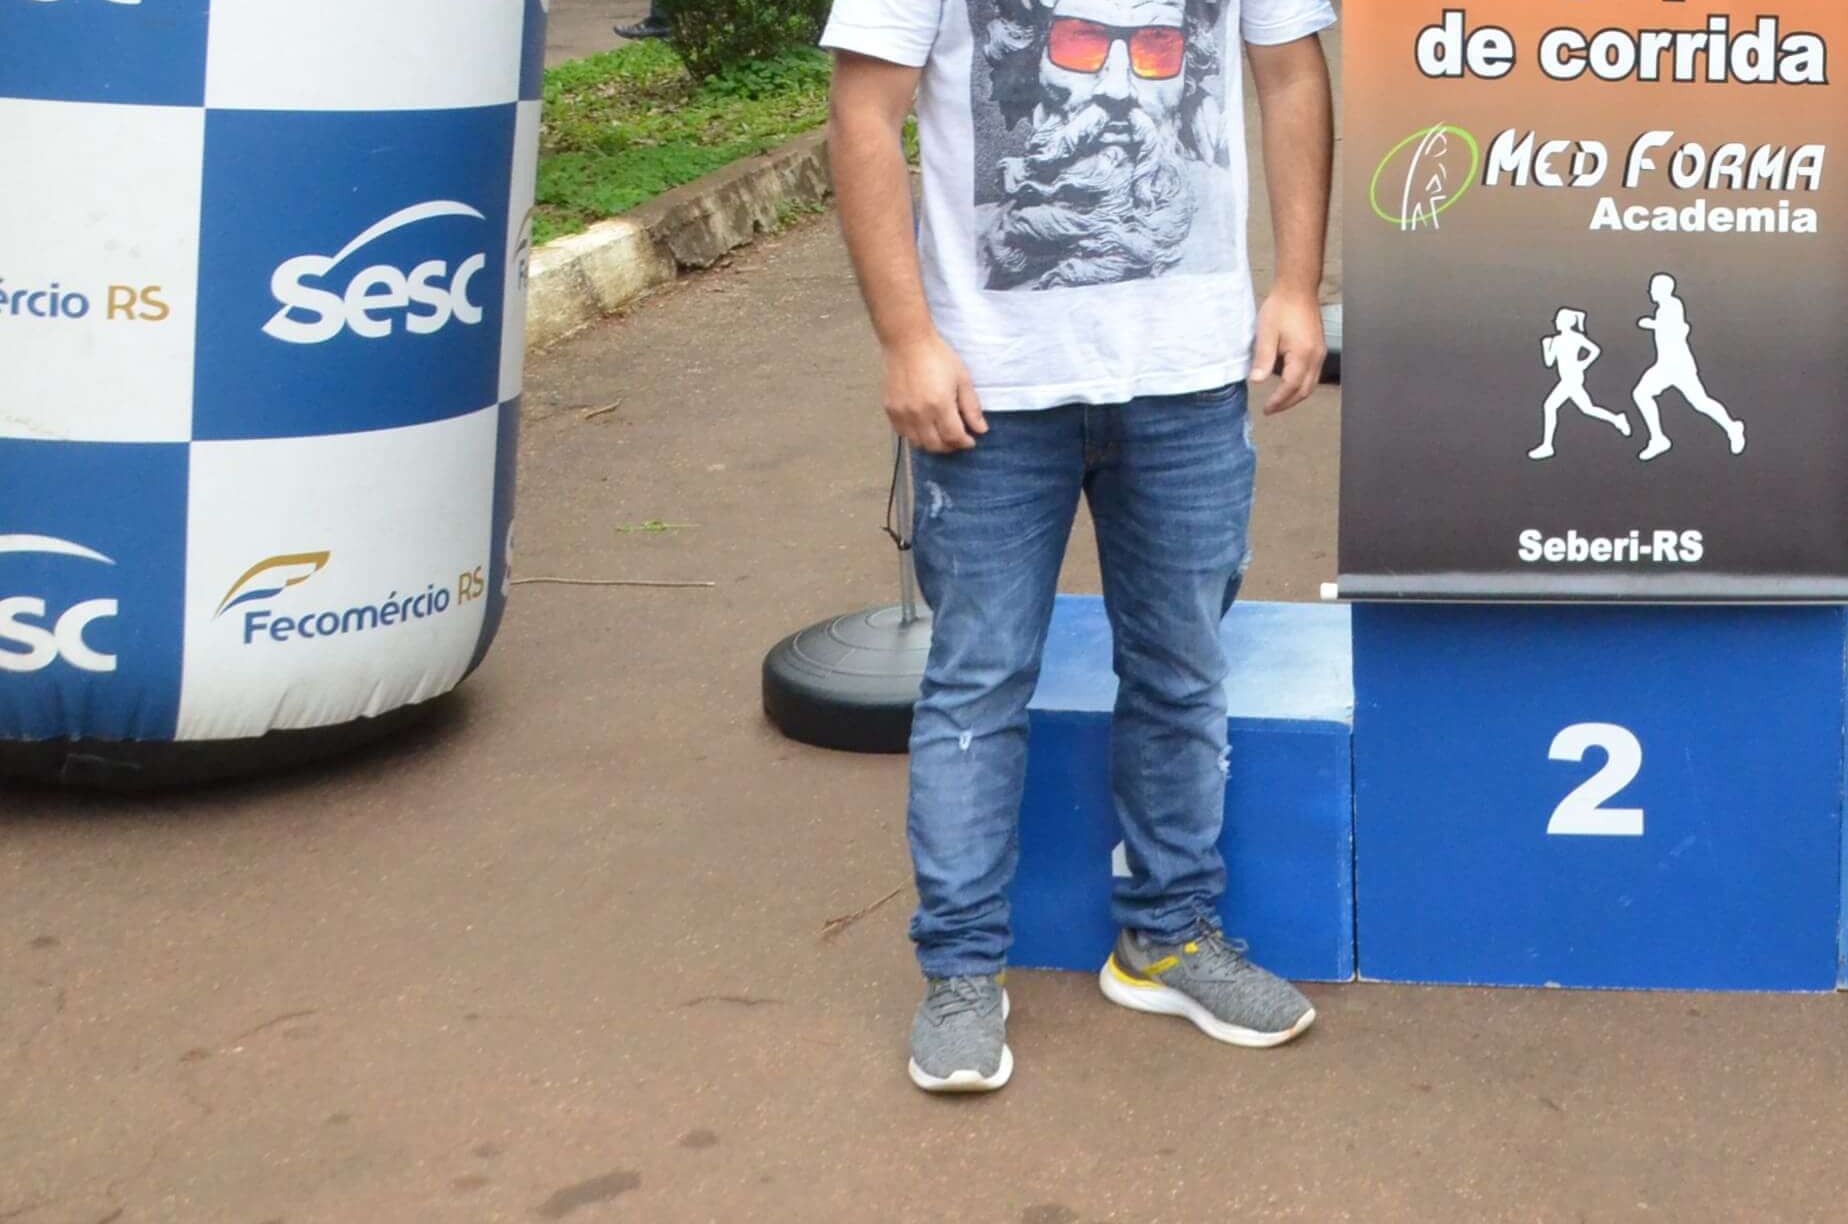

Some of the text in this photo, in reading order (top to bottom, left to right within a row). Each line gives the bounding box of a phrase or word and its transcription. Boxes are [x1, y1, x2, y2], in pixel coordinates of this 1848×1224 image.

[1415, 9, 1829, 85] de corrida
[1622, 130, 1826, 191] FORMA
[1589, 196, 1818, 233] Academia
[106, 284, 171, 322] RS
[261, 252, 486, 344] Sesc
[1517, 528, 1705, 563] Seberi-RS
[243, 565, 486, 645] Fecomércio RS
[1546, 722, 1644, 836] 2
